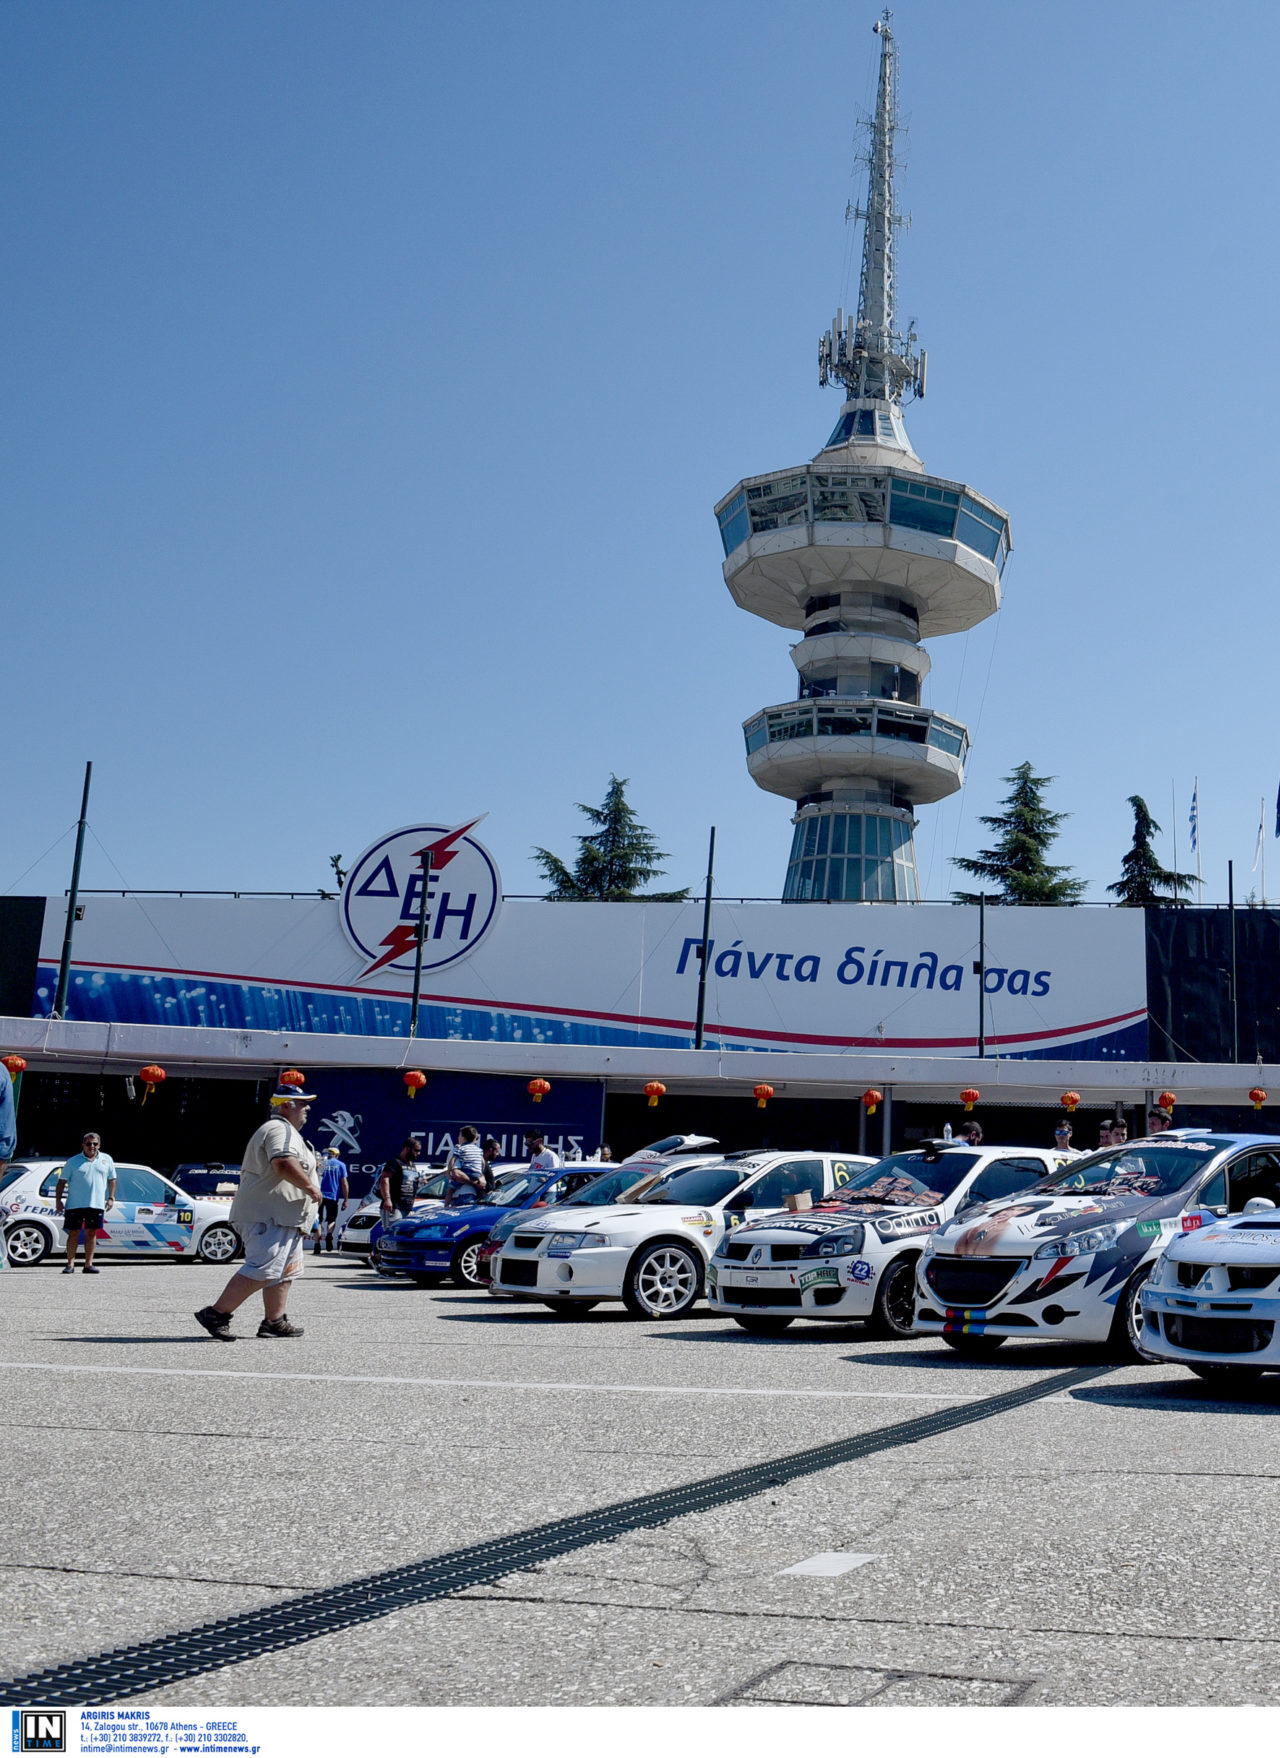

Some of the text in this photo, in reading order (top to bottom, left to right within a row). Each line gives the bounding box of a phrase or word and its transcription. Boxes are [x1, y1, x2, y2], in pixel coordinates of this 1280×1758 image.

[354, 854, 477, 940] ΔΕΗ
[675, 937, 1052, 997] Πάντα δίπλα σας
[834, 1162, 849, 1187] 6
[179, 1212, 192, 1222] 10
[875, 1210, 938, 1236] Optima
[855, 1263, 868, 1276] 22
